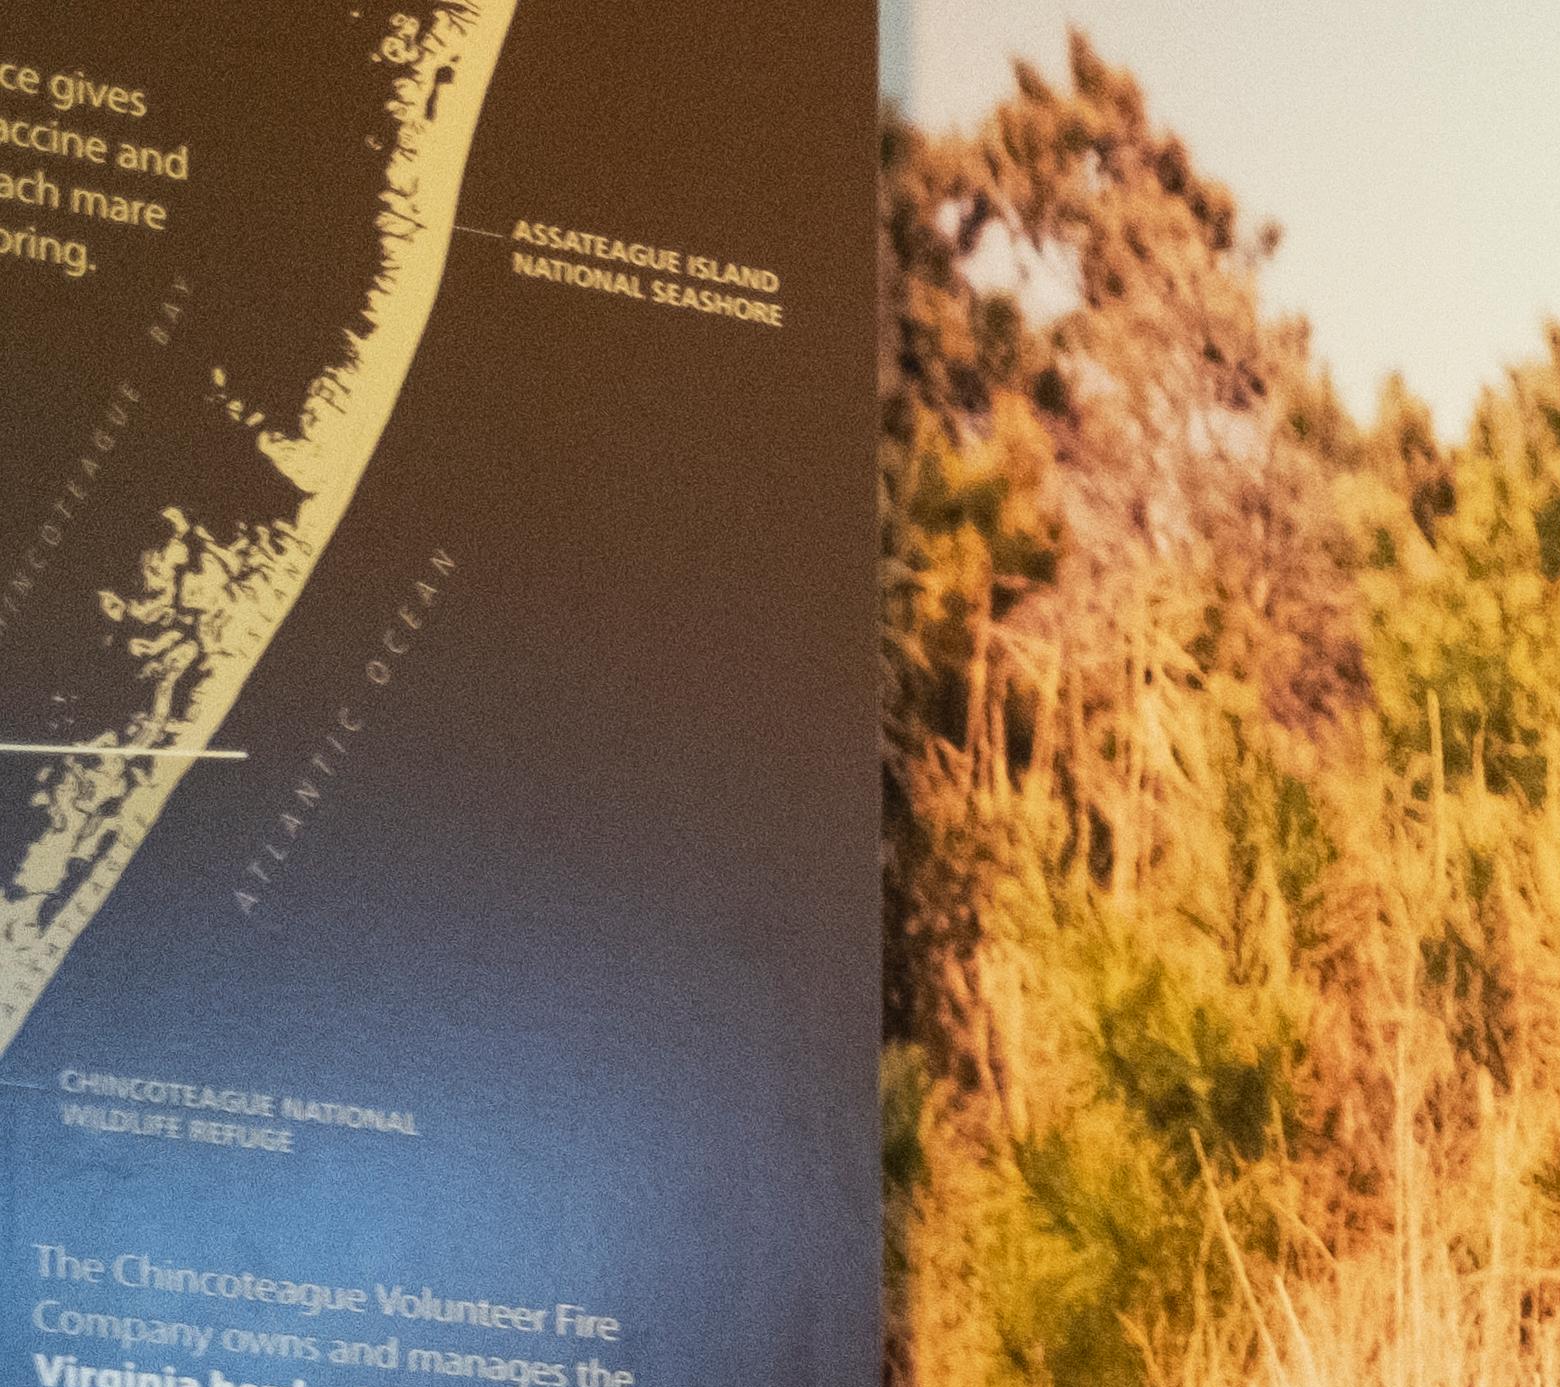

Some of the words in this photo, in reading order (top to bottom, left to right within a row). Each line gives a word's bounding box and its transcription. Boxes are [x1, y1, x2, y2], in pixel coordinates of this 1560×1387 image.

[49, 70, 148, 117] gives
[116, 143, 190, 180] and
[70, 187, 167, 230] mare
[511, 219, 682, 275] ASSATEAGUE
[686, 255, 781, 294] ISLAND
[511, 252, 646, 300] NATIONAL
[651, 278, 783, 328] SEASHORE
[234, 705, 363, 915] ATLANTIC
[365, 549, 455, 685] OCEAN
[59, 1068, 275, 1119] CHINCOTEAGUE
[282, 1098, 422, 1137] NATIONAL
[61, 1103, 184, 1140] WILDLIFE
[188, 1120, 296, 1154] REFUGE
[30, 1242, 106, 1285] The
[112, 1252, 368, 1318] Chincoteague
[374, 1282, 550, 1334] Volunteer
[555, 1301, 621, 1344] Fire
[31, 1297, 214, 1358] Company
[221, 1327, 322, 1362] owns
[328, 1335, 400, 1370] and
